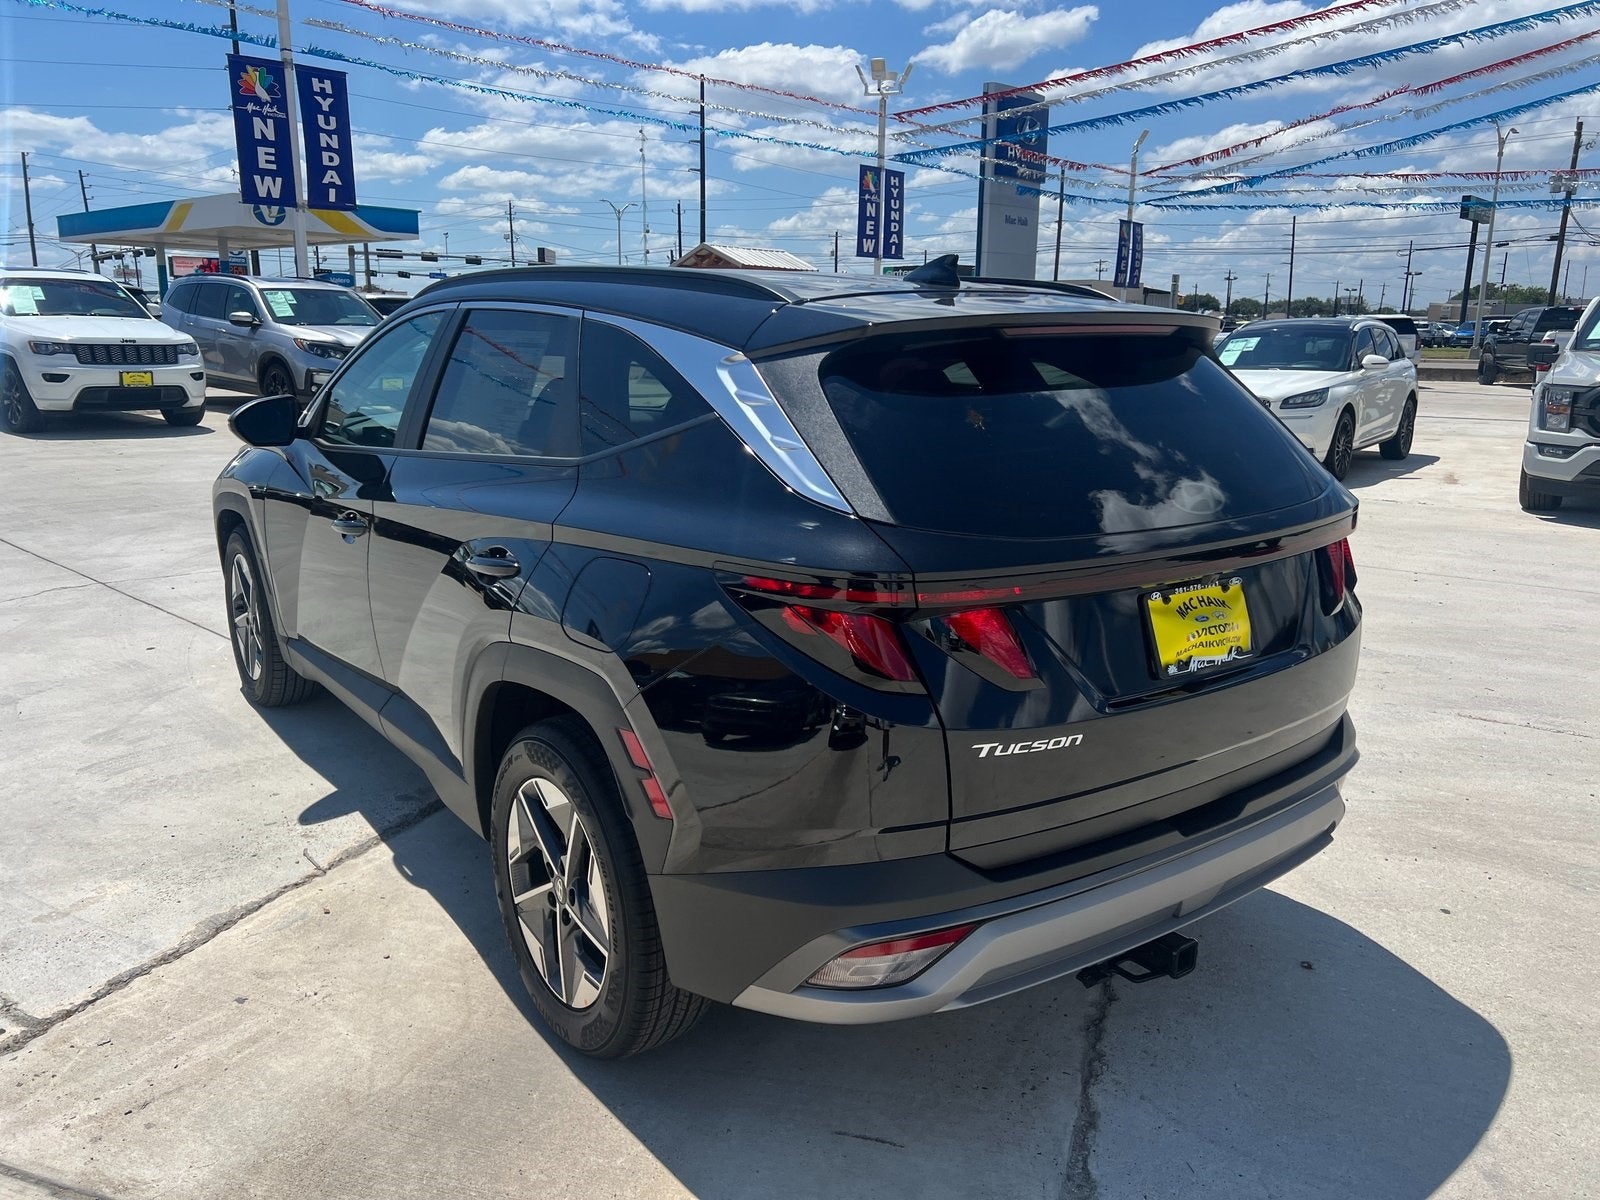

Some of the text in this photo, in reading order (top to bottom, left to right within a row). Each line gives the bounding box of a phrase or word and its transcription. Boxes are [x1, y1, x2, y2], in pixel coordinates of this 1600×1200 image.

[239, 102, 262, 114] Mac
[253, 116, 283, 199] NEW
[312, 77, 343, 203] HYUNDAI
[862, 202, 876, 253] NEW
[889, 176, 900, 255] HYUNDAI
[1004, 214, 1017, 225] Mac
[1117, 246, 1129, 284] NEW
[1133, 226, 1142, 285] HYUNDAI
[1175, 595, 1233, 621] MAC HAIK
